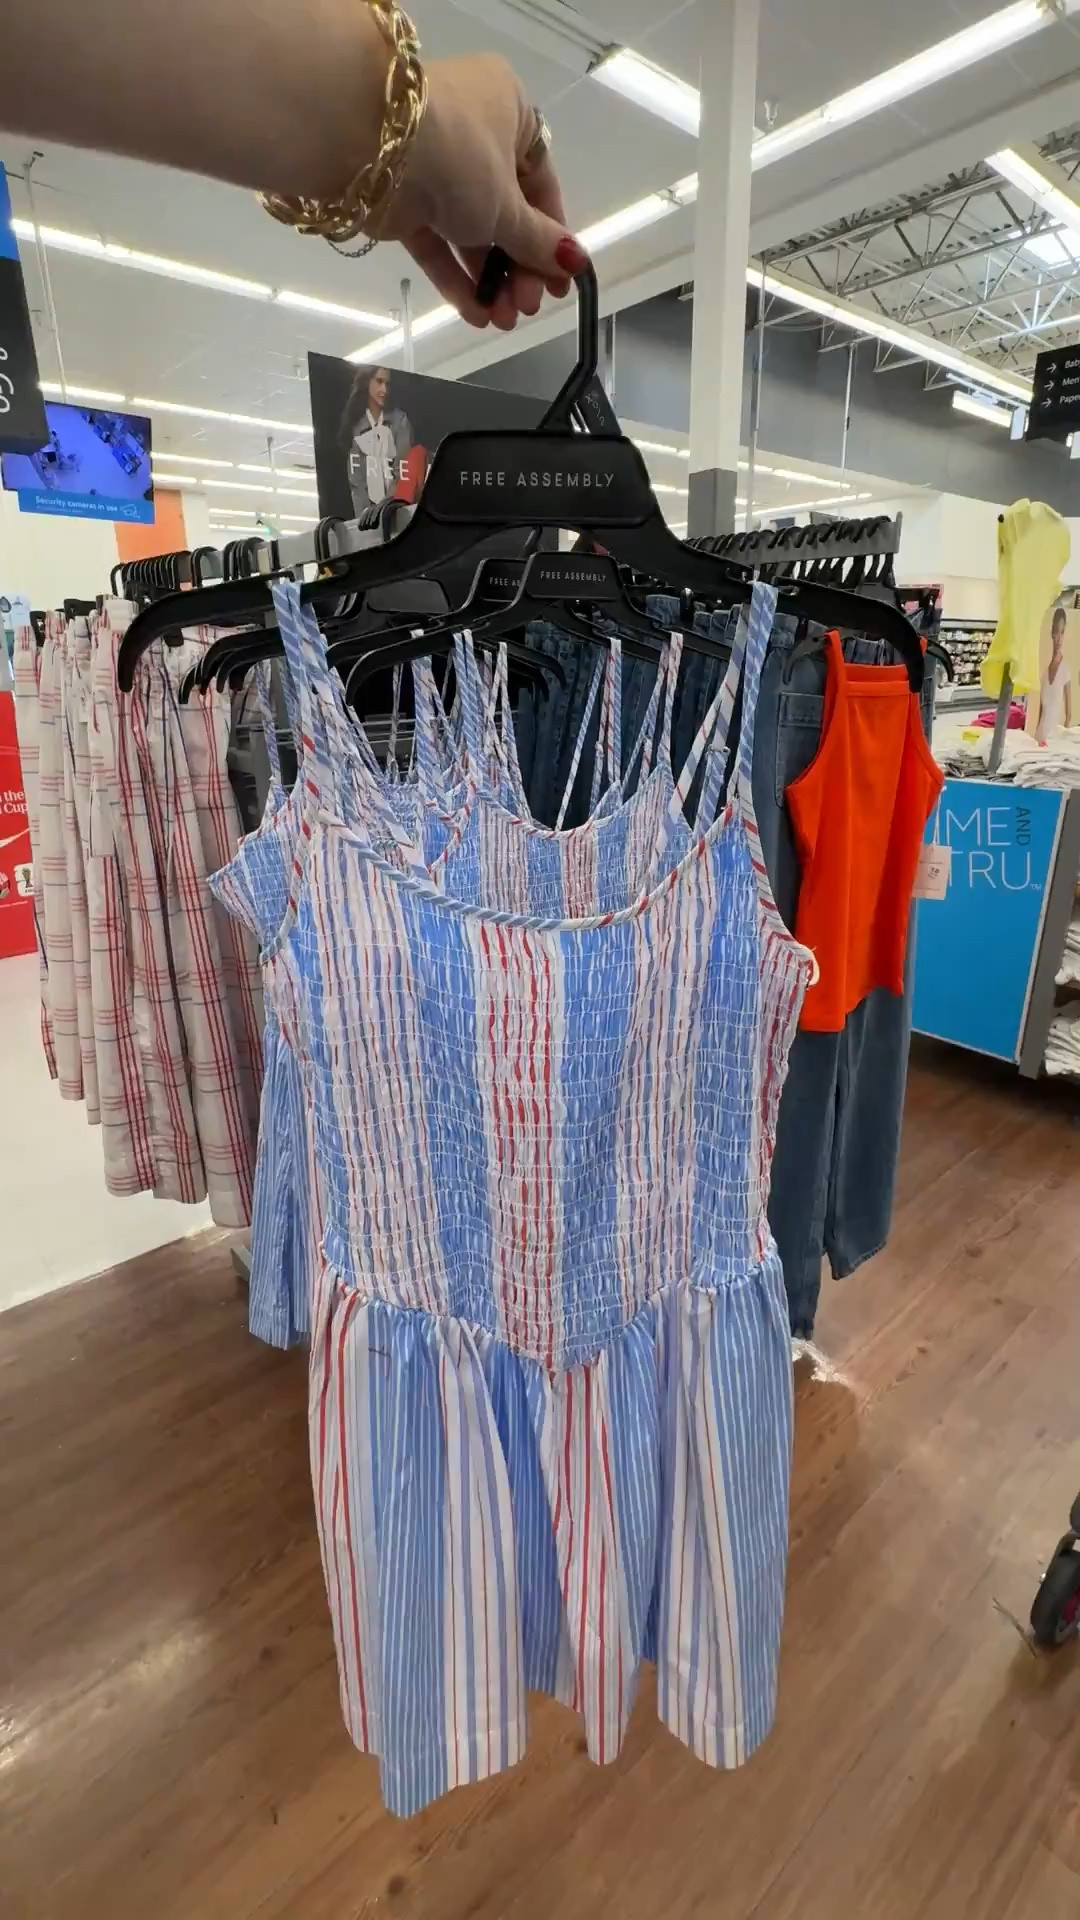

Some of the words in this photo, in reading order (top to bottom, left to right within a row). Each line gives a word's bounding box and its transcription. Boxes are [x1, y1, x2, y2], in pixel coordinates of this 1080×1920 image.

[349, 453, 410, 480] FREE
[460, 471, 506, 487] FREE
[516, 471, 615, 488] ASSEMBLY
[540, 570, 561, 580] FREE
[564, 571, 607, 583] ASSEMBLY
[3, 789, 25, 801] the
[3, 802, 28, 814] Cup
[1015, 806, 1032, 847] AND
